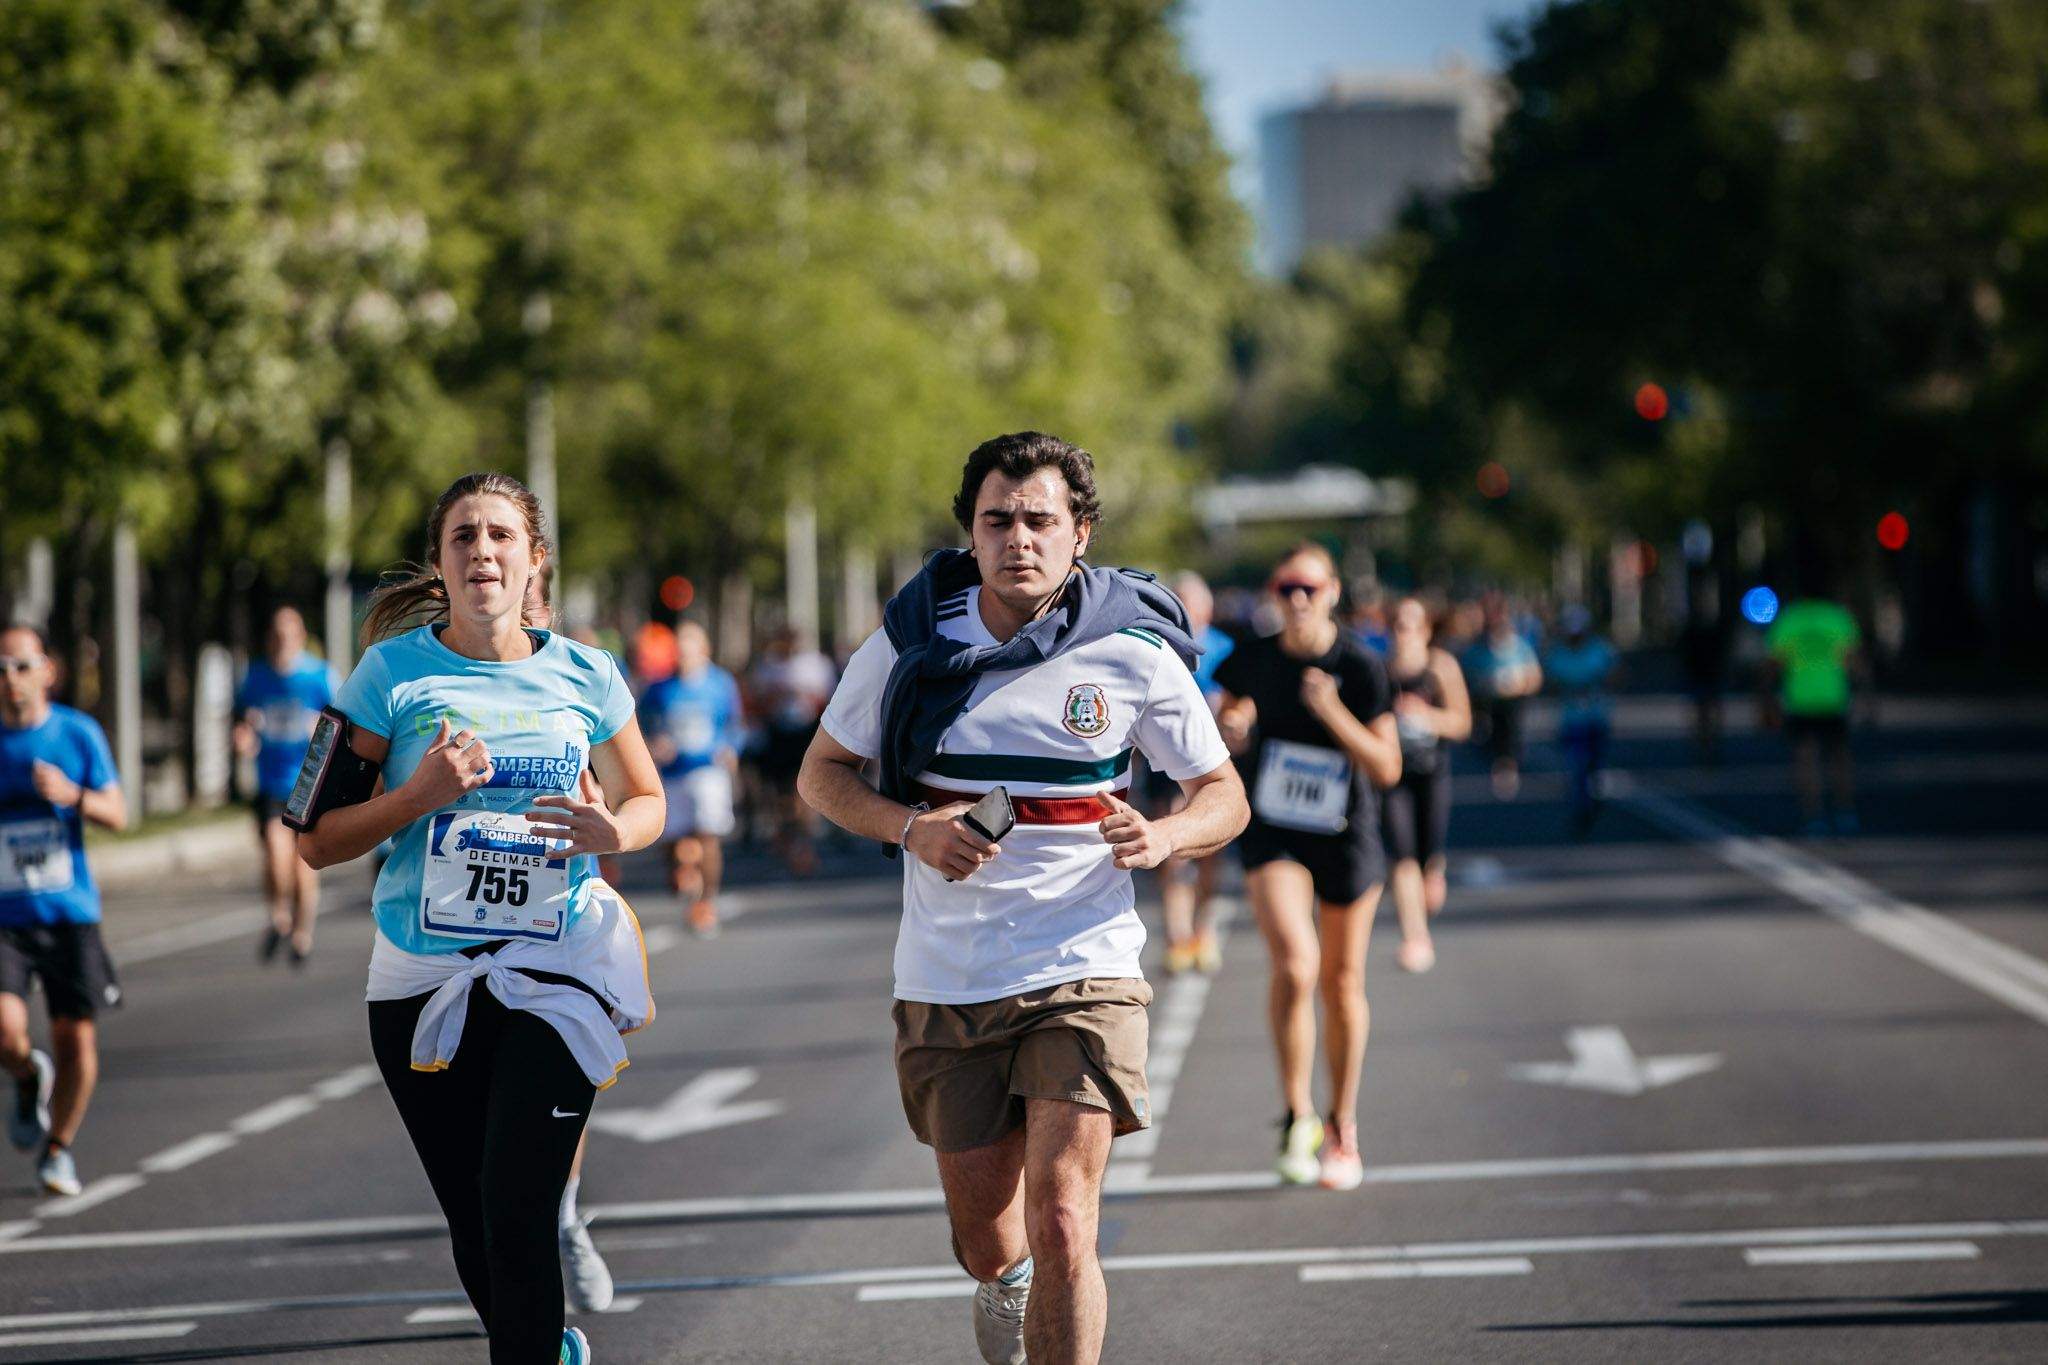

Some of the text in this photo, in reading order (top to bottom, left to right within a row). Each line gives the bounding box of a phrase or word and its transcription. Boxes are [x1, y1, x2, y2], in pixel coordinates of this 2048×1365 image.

[511, 772, 575, 791] de MADRID
[480, 829, 545, 845] BOMBEROS
[469, 850, 541, 867] DECIMAS
[465, 864, 529, 907] 755
